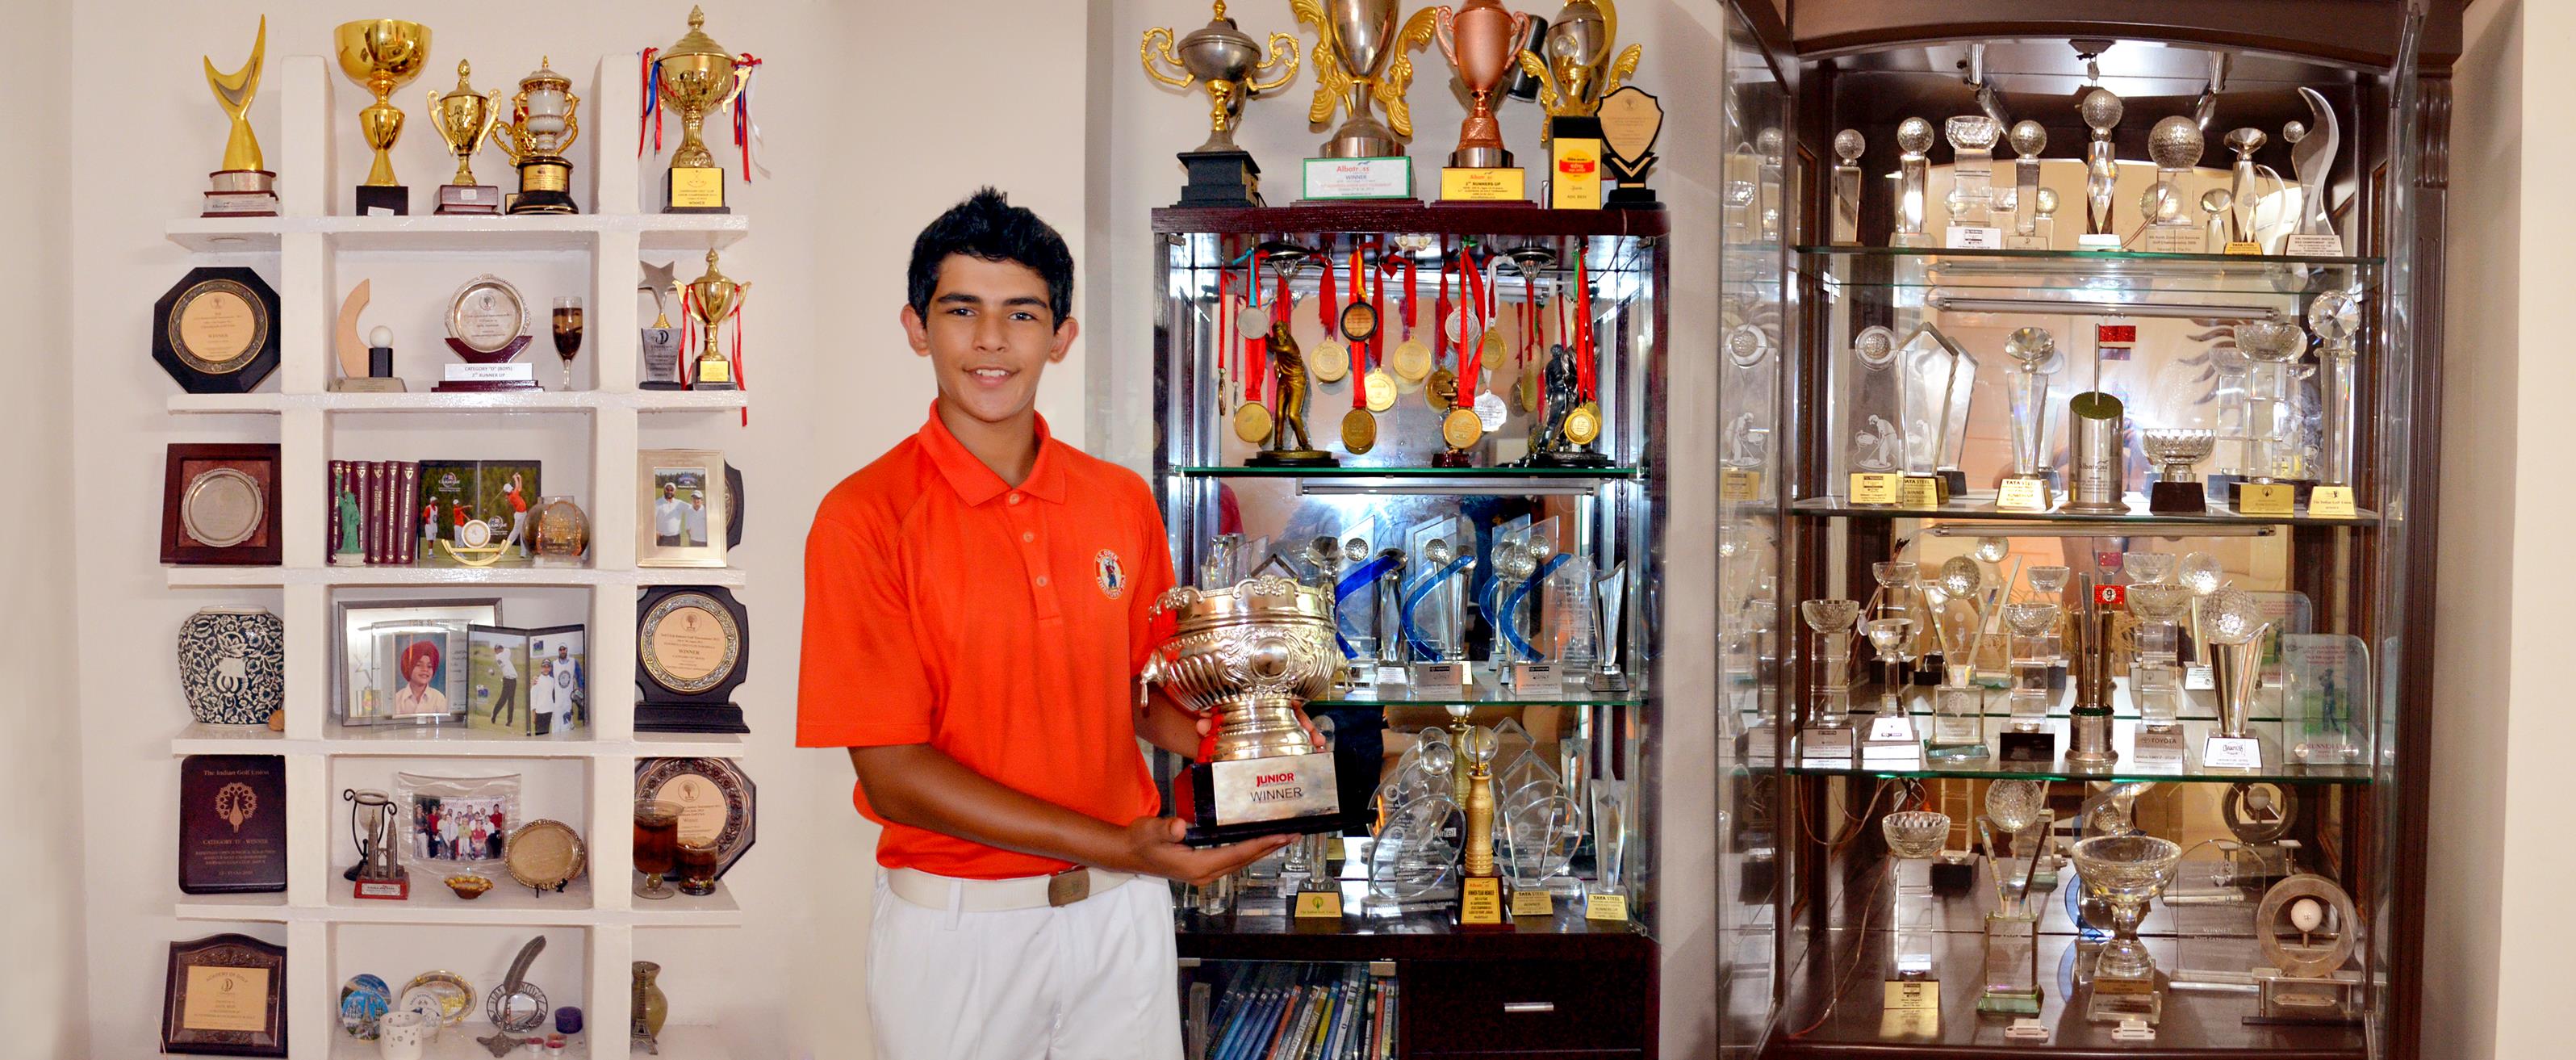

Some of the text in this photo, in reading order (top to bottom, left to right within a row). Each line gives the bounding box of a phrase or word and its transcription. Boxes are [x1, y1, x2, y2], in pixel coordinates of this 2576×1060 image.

[2106, 589, 2113, 601] 9
[1256, 772, 1295, 788] JUNIOR
[1250, 786, 1303, 802] WINNER
[2202, 926, 2233, 934] WINNER
